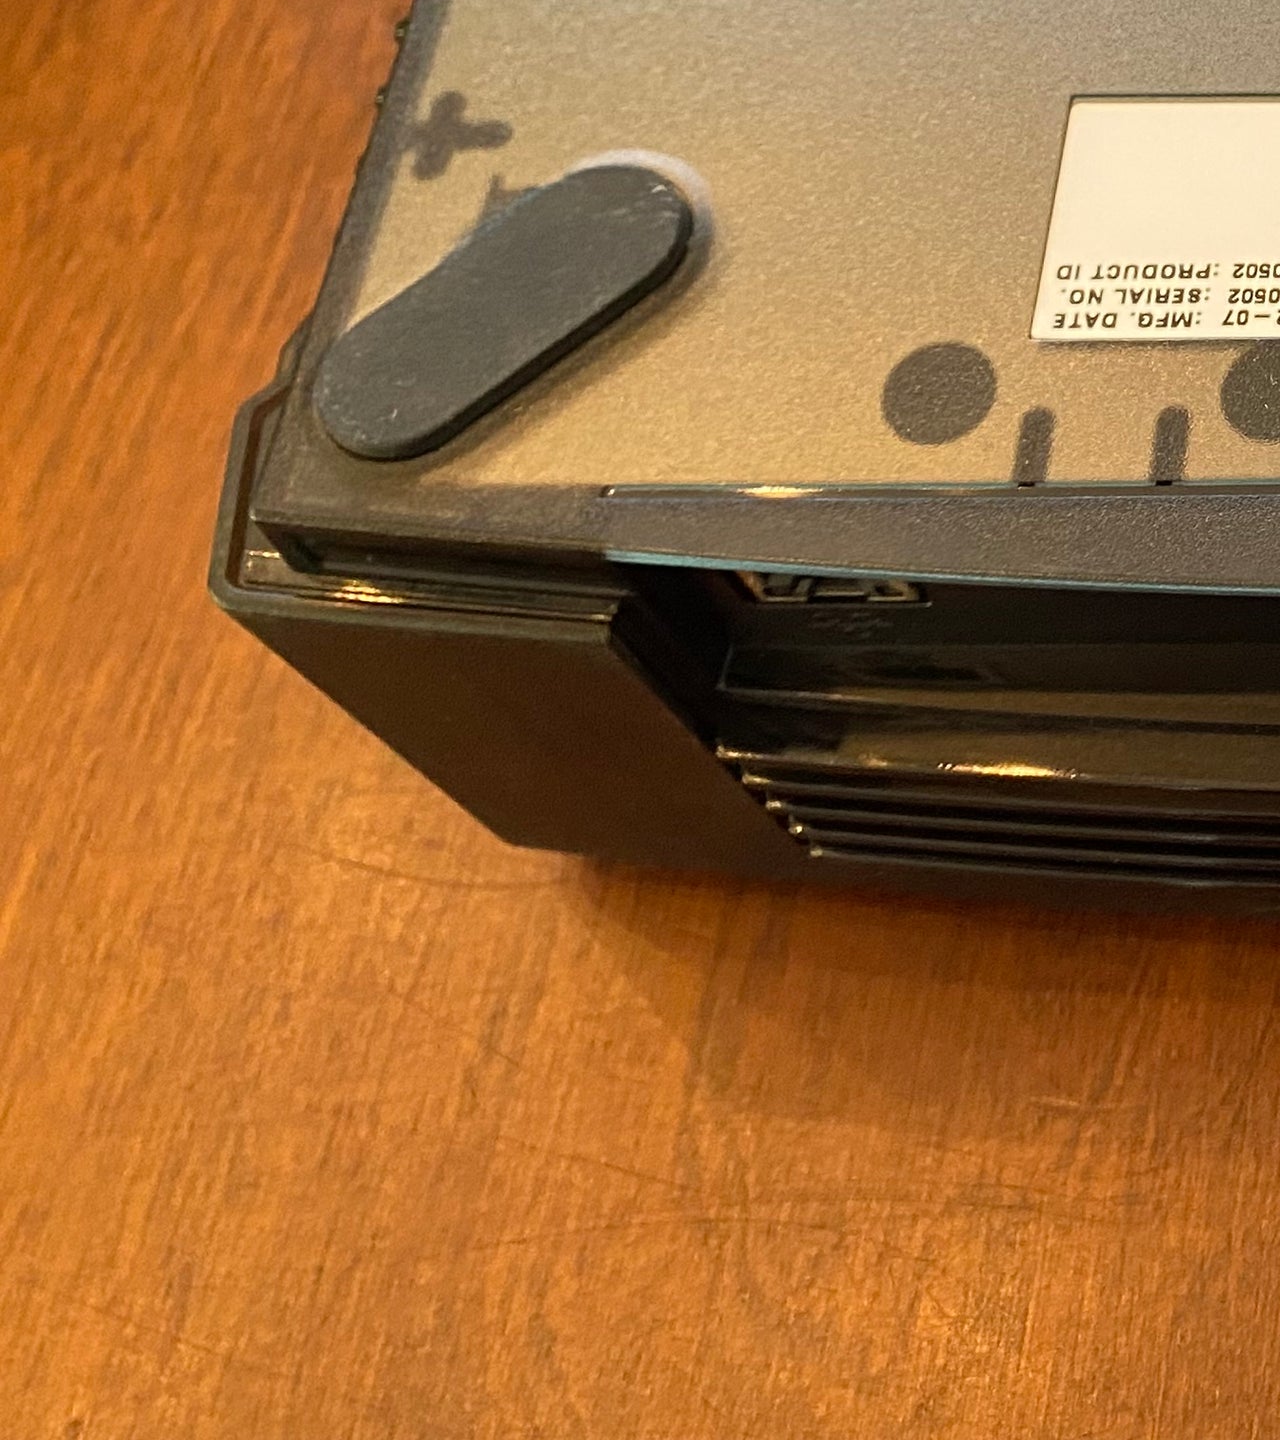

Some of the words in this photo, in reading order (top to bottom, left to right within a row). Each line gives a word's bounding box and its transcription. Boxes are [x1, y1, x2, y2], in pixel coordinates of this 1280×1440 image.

[1056, 265, 1081, 281] ID
[1061, 289, 1104, 305] NO.
[1053, 312, 1118, 329] DATE
